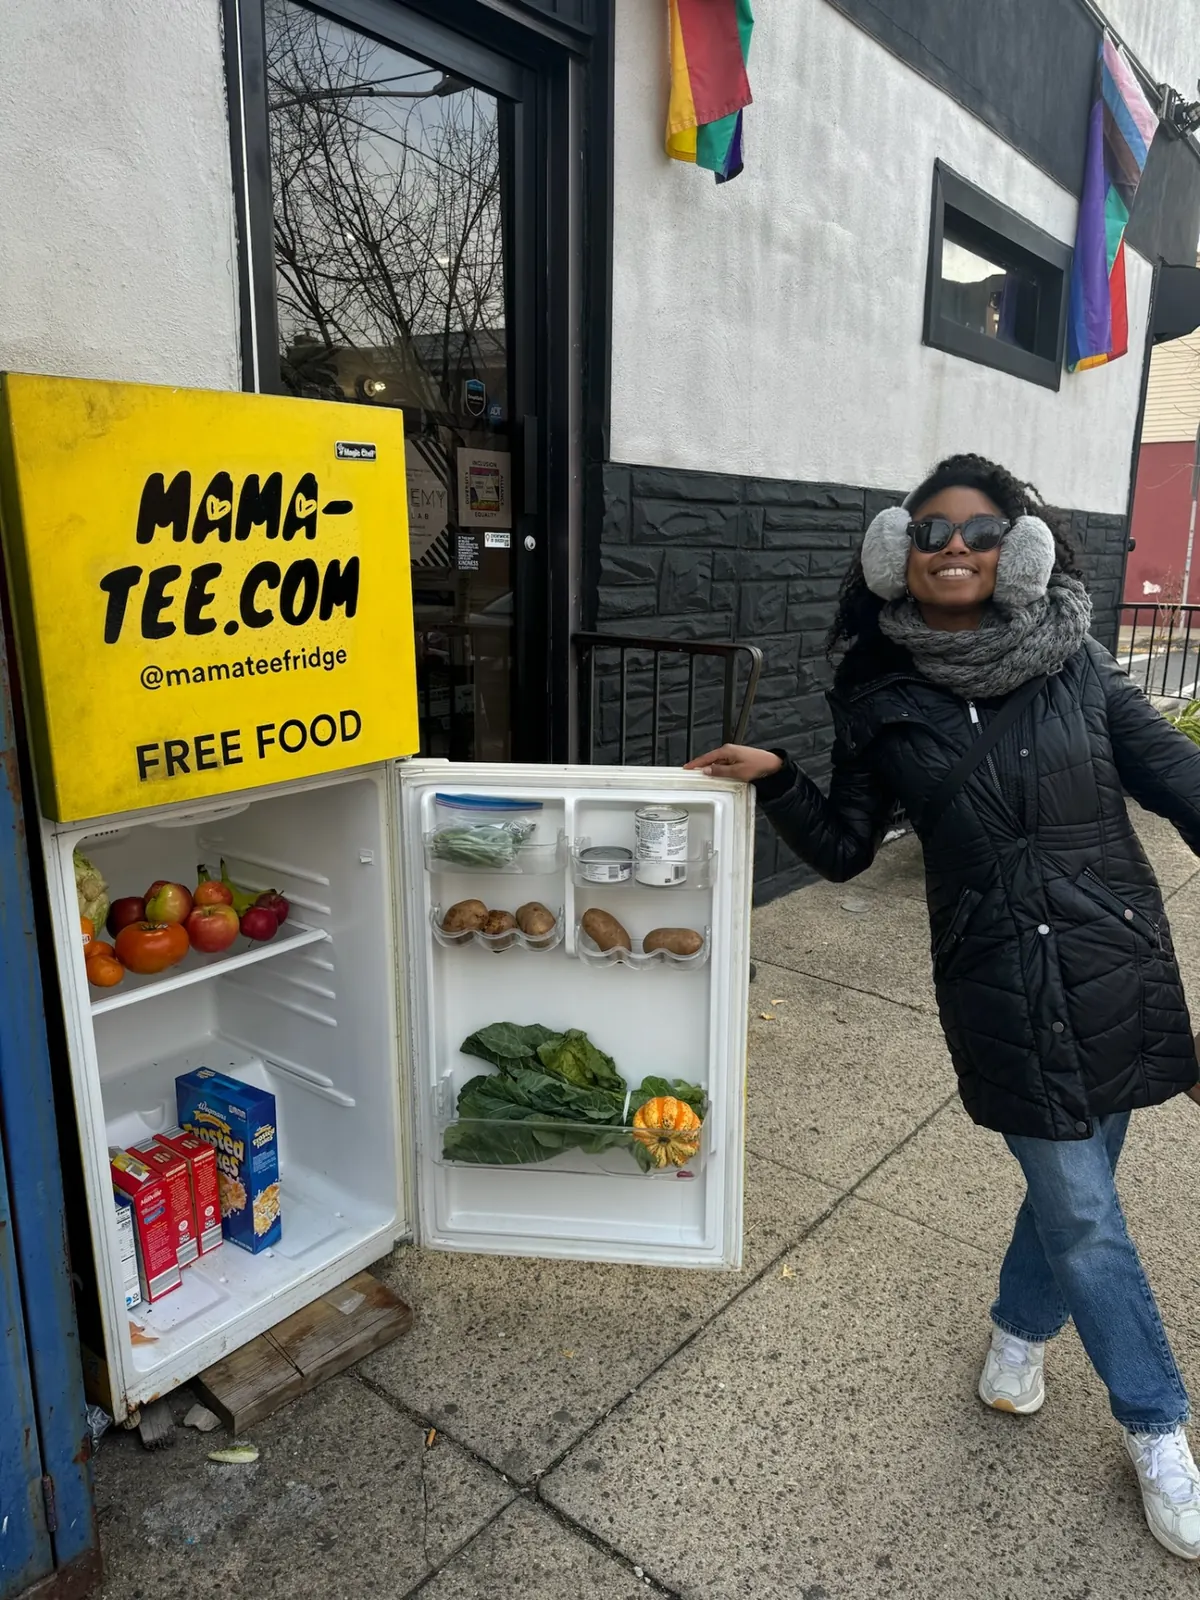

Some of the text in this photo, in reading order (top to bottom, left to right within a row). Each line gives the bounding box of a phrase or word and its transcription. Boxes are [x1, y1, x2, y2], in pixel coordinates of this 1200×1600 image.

[490, 406, 502, 415] ADT
[344, 448, 374, 457] Magic Chef
[472, 460, 498, 468] INCLUSION
[135, 470, 354, 544] MAMA-
[410, 488, 446, 508] EMY
[99, 555, 360, 644] TEE.COM
[139, 646, 347, 690] @mamateefridge
[136, 708, 362, 782] FREE FOOD
[198, 1101, 227, 1121] Wegmans
[217, 1153, 239, 1177] kes
